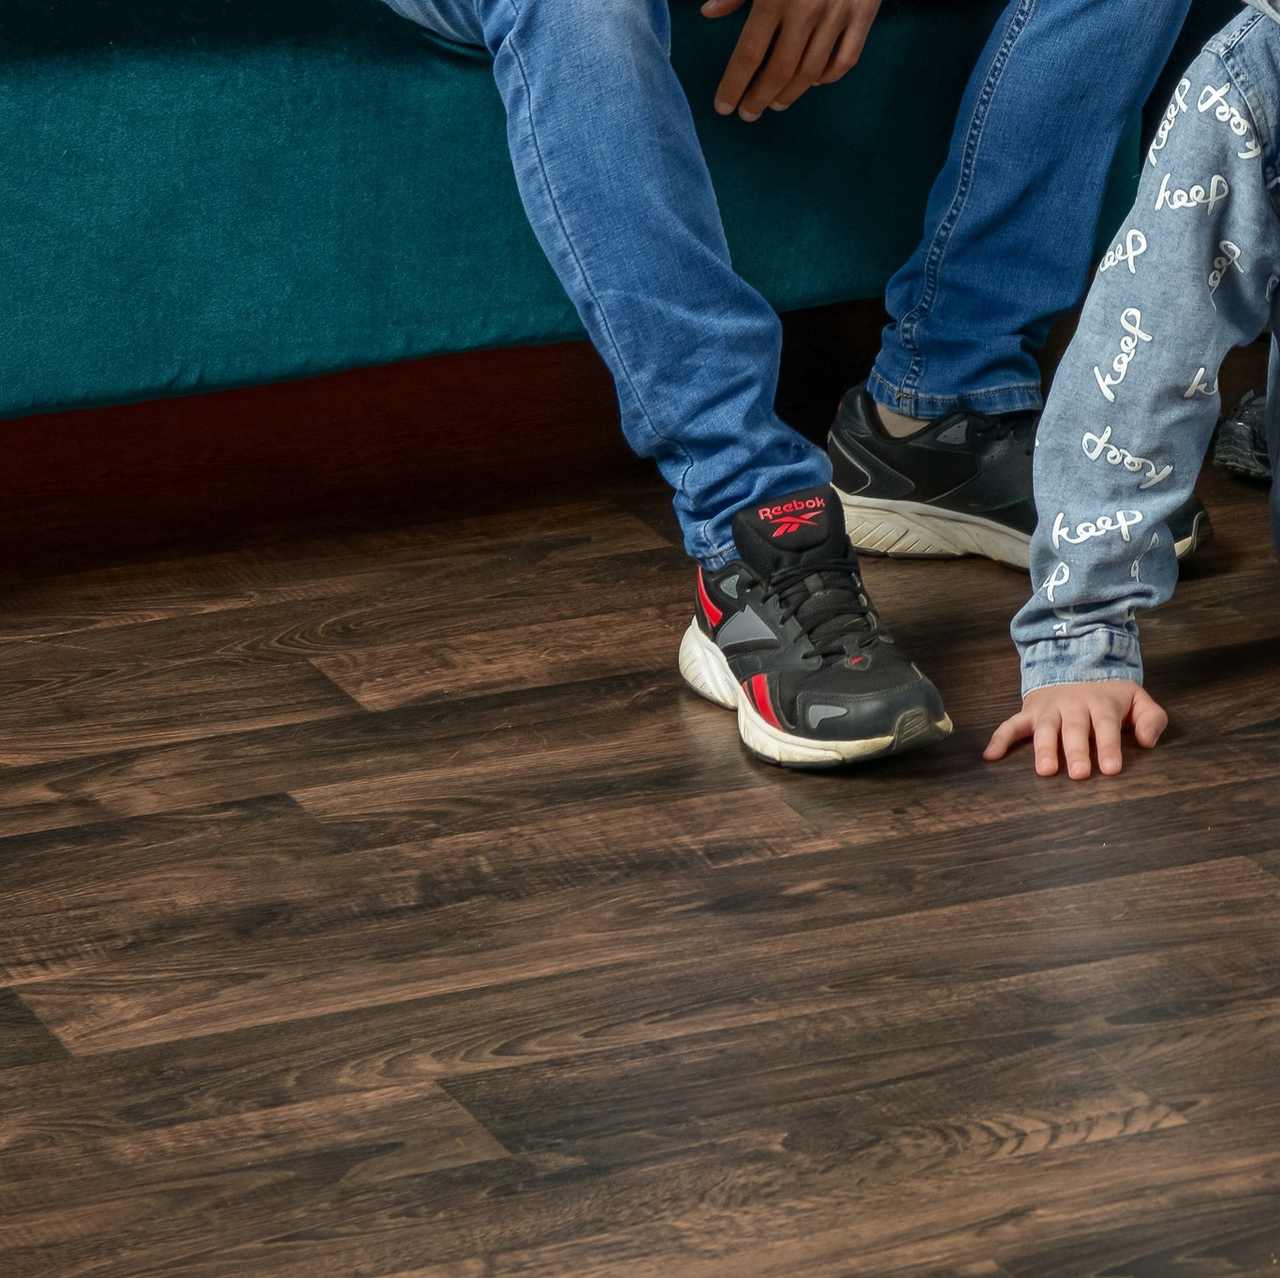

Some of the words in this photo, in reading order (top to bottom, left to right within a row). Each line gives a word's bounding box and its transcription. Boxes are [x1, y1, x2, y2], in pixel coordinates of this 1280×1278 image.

[1197, 81, 1262, 160] keep
[1155, 173, 1230, 216] keep
[1099, 228, 1149, 276] eep
[1093, 306, 1154, 403] keep
[1081, 424, 1174, 490] keep
[758, 497, 826, 521] Reebok
[1051, 509, 1144, 550] keep
